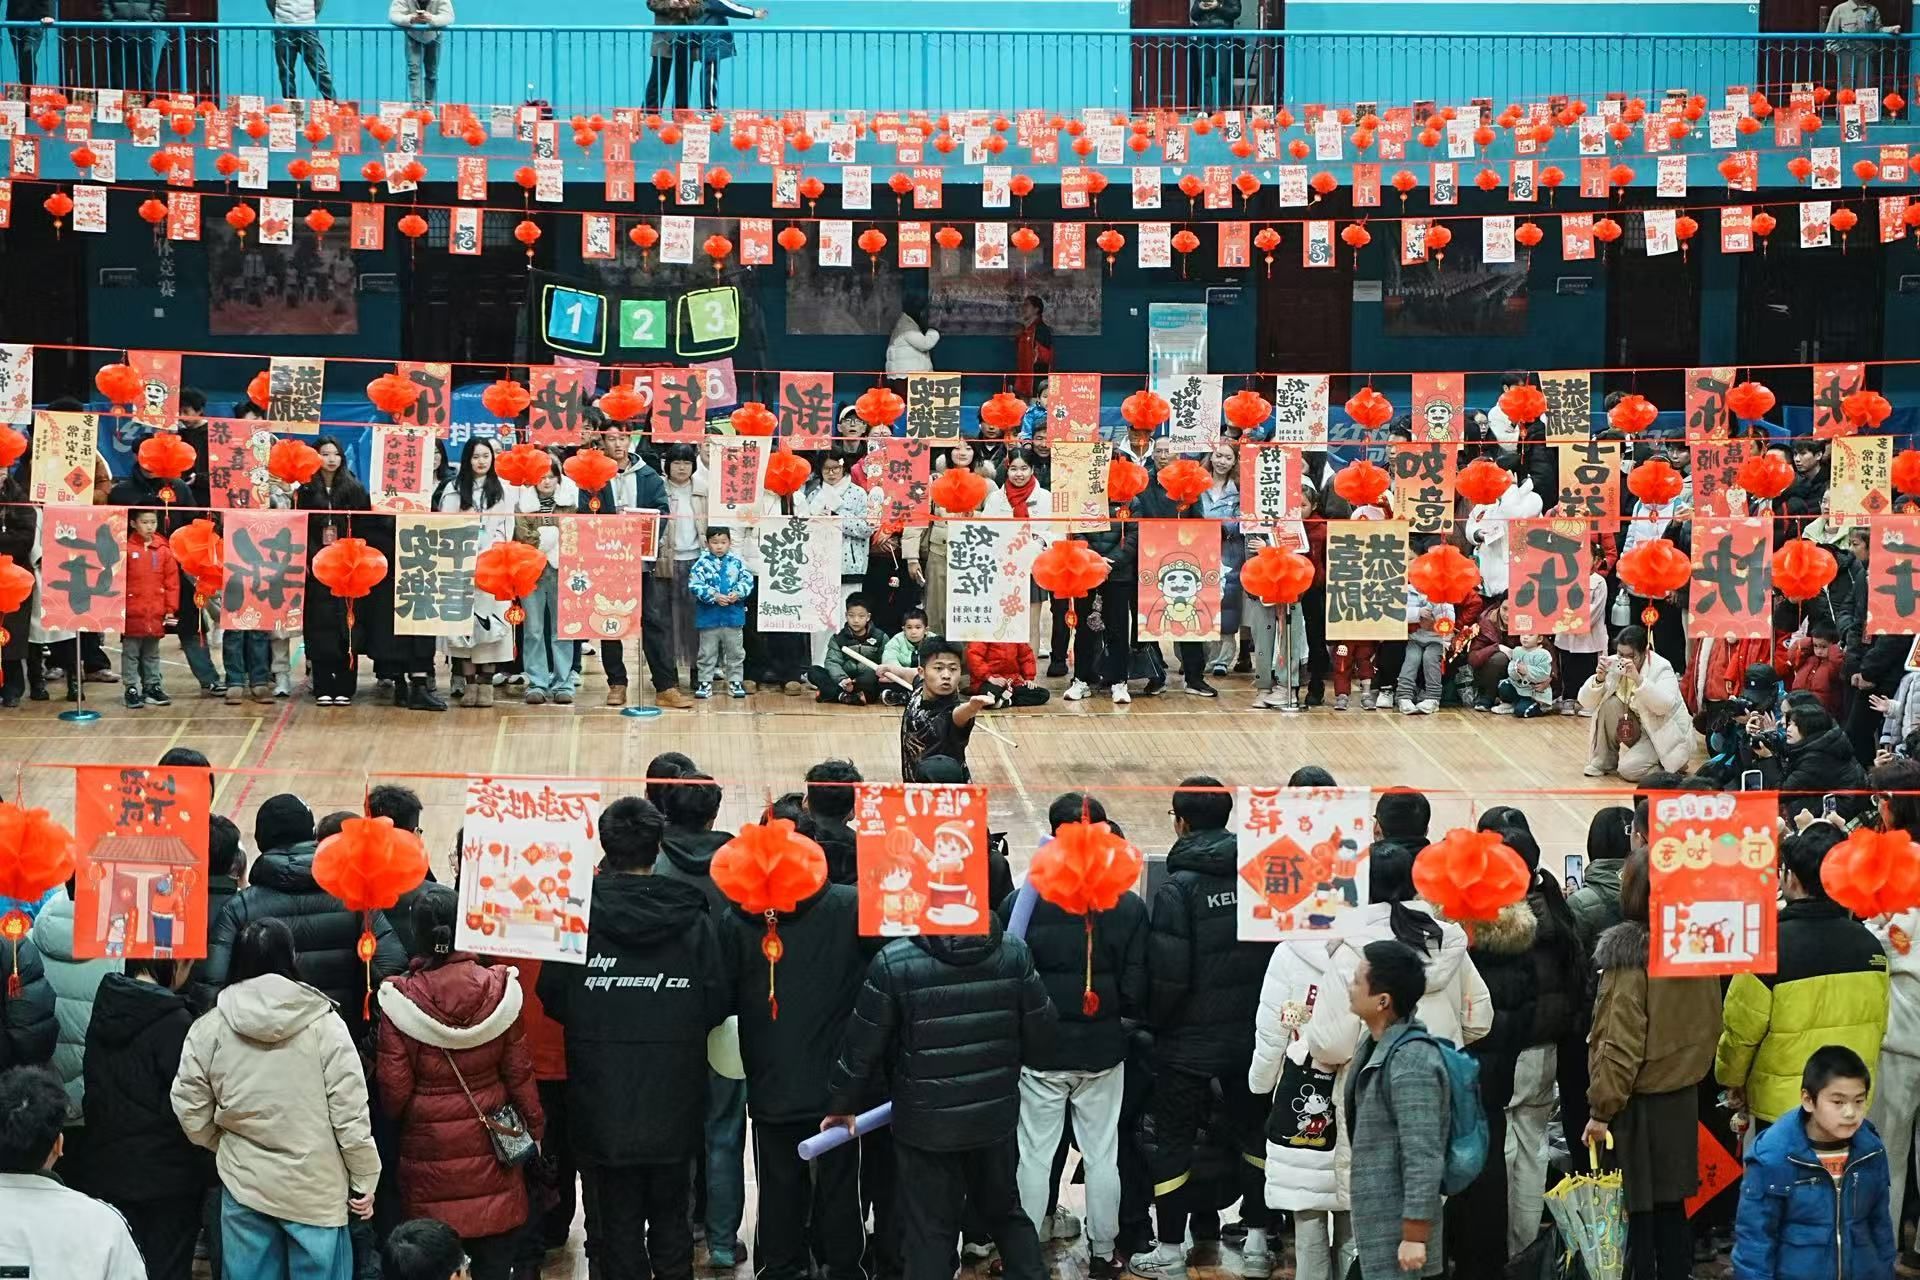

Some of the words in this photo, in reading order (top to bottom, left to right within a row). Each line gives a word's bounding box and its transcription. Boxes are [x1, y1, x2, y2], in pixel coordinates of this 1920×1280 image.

[566, 302, 583, 334] 1
[632, 308, 654, 341] 2
[704, 301, 725, 333] 3
[633, 375, 654, 408] 5
[706, 368, 725, 400] 6
